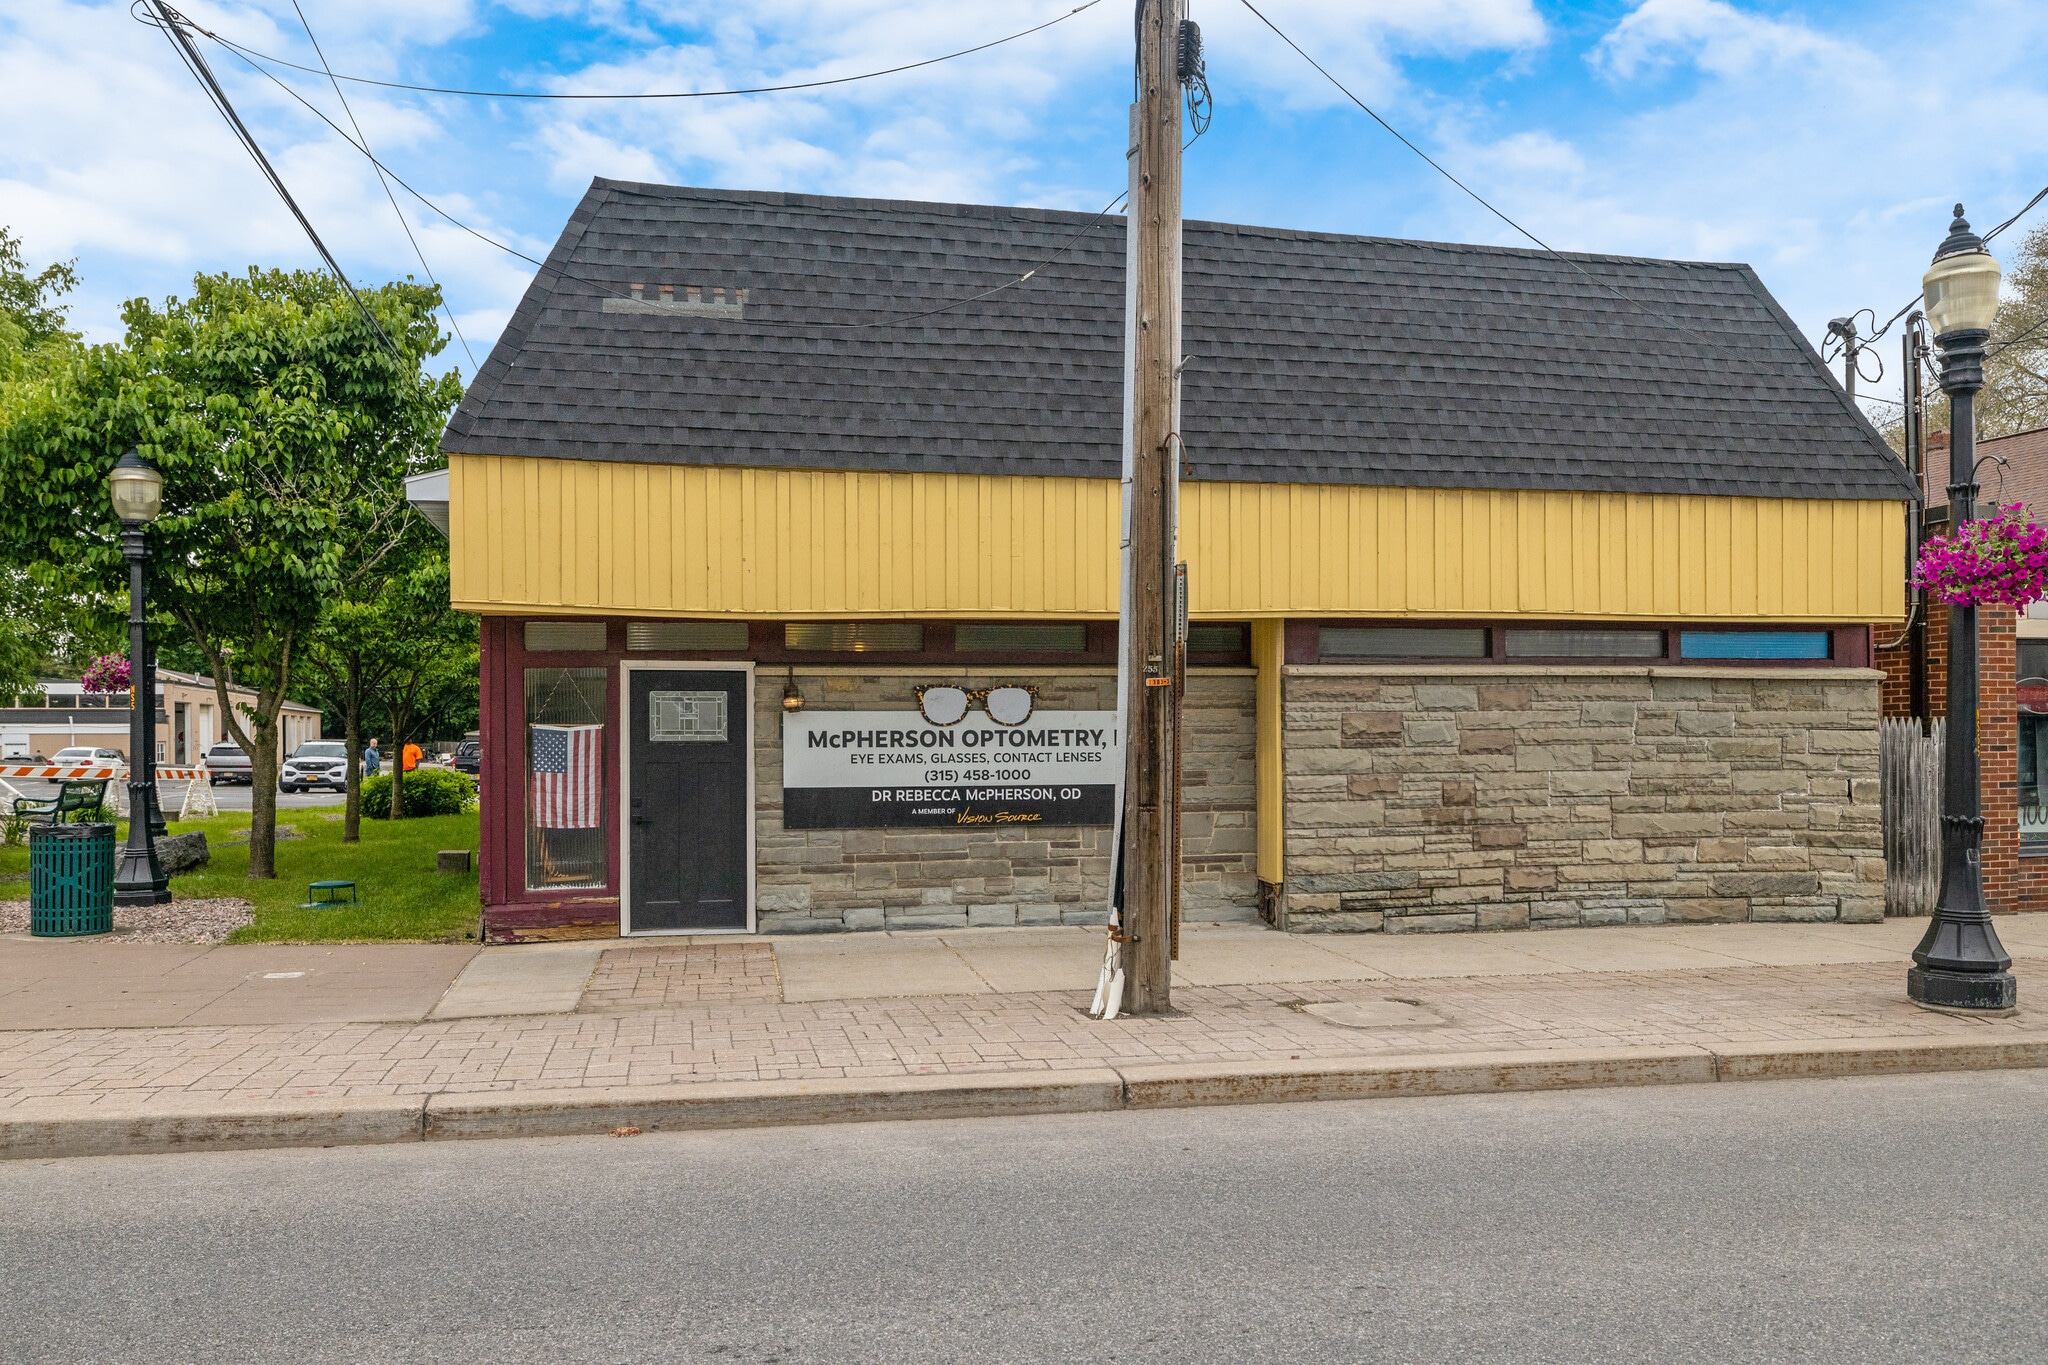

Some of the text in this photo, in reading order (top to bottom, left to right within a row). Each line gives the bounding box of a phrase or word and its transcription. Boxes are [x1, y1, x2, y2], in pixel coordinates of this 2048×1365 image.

[808, 730, 954, 748] McPHERSON
[961, 729, 1107, 749] OPTOMETRY,
[850, 752, 1102, 765] EYE EXAMS, GLASSES, CONTACT LENSES
[924, 769, 1031, 783] (315) 458-1000
[872, 788, 1082, 802] DR REBECCA McPHERSON, OD
